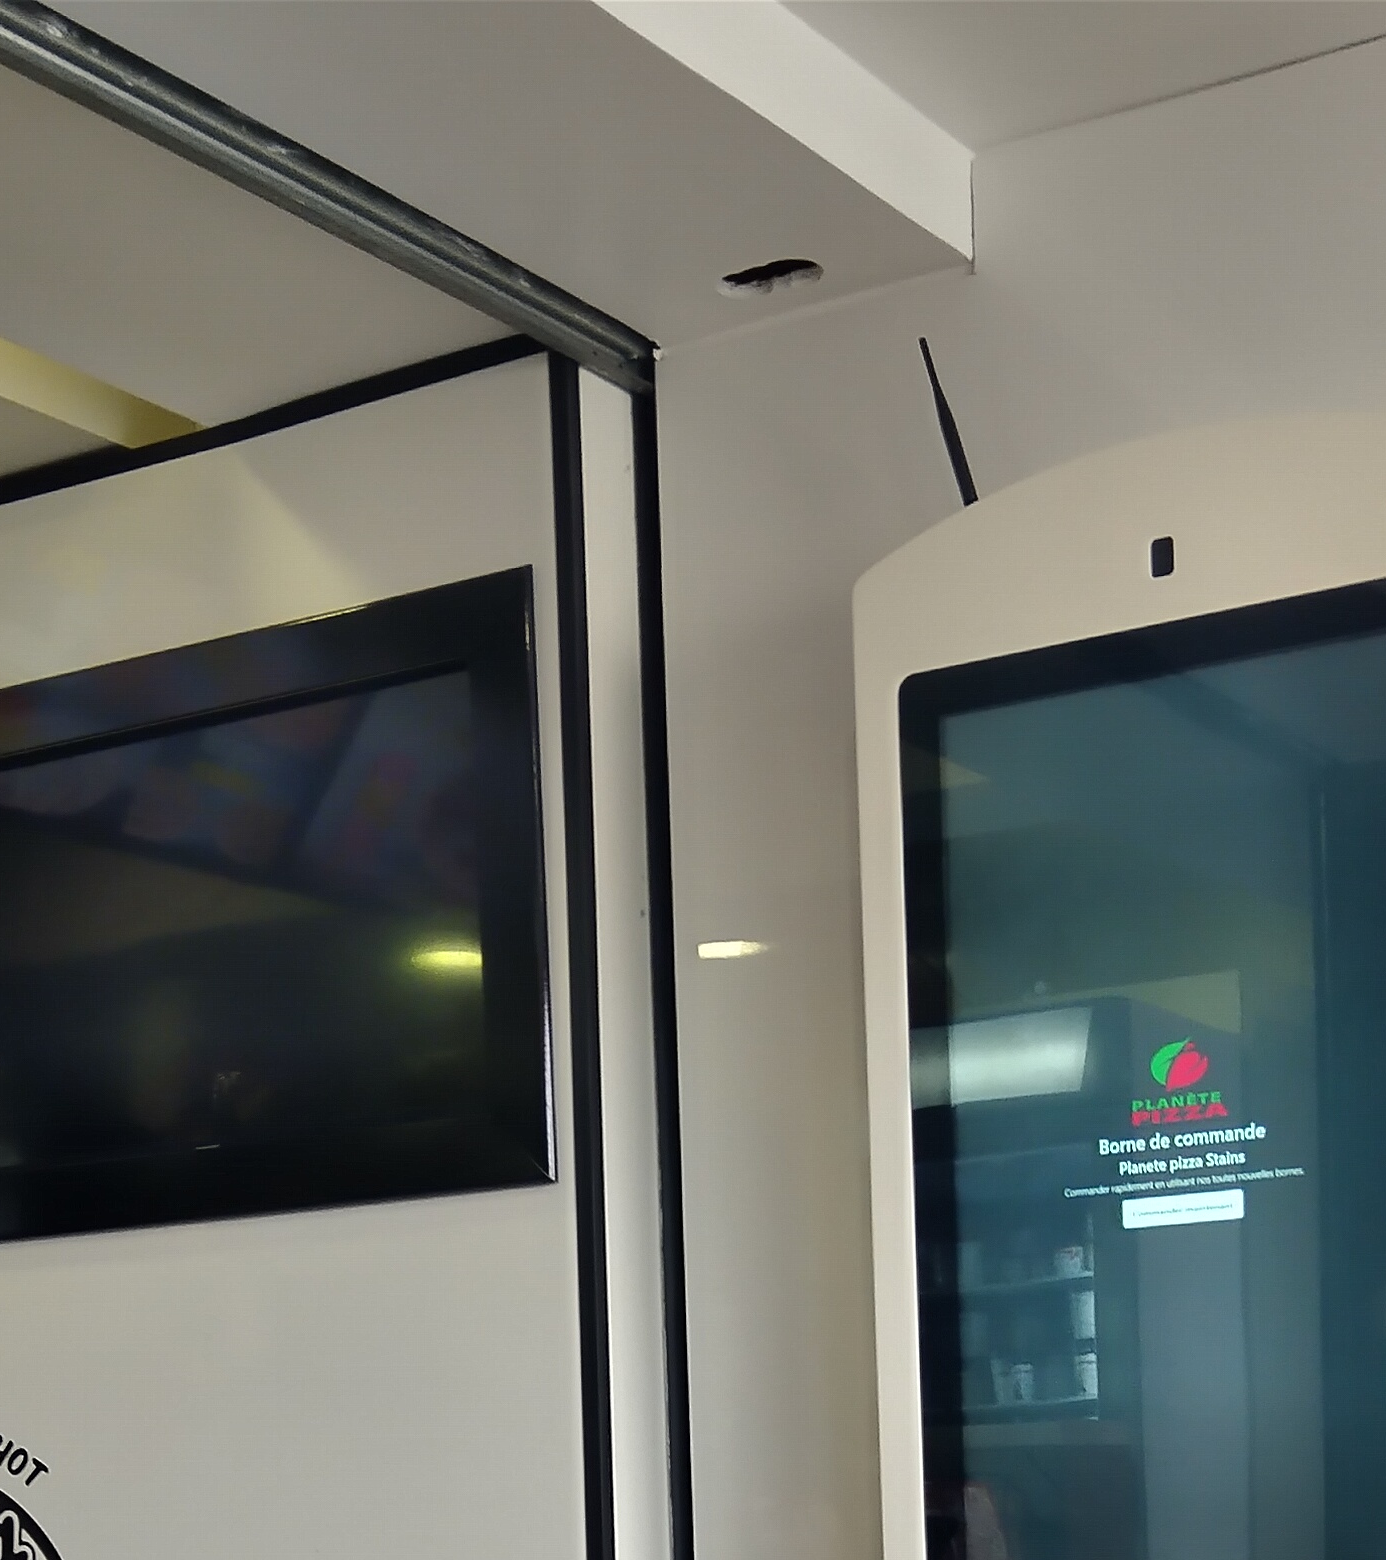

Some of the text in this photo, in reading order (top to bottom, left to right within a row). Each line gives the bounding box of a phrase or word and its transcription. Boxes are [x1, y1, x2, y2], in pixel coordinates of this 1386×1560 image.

[1130, 1102, 1229, 1127] PIZZA
[1098, 1121, 1266, 1156] Borne de commande
[1119, 1151, 1246, 1177] Planete pizza Stains
